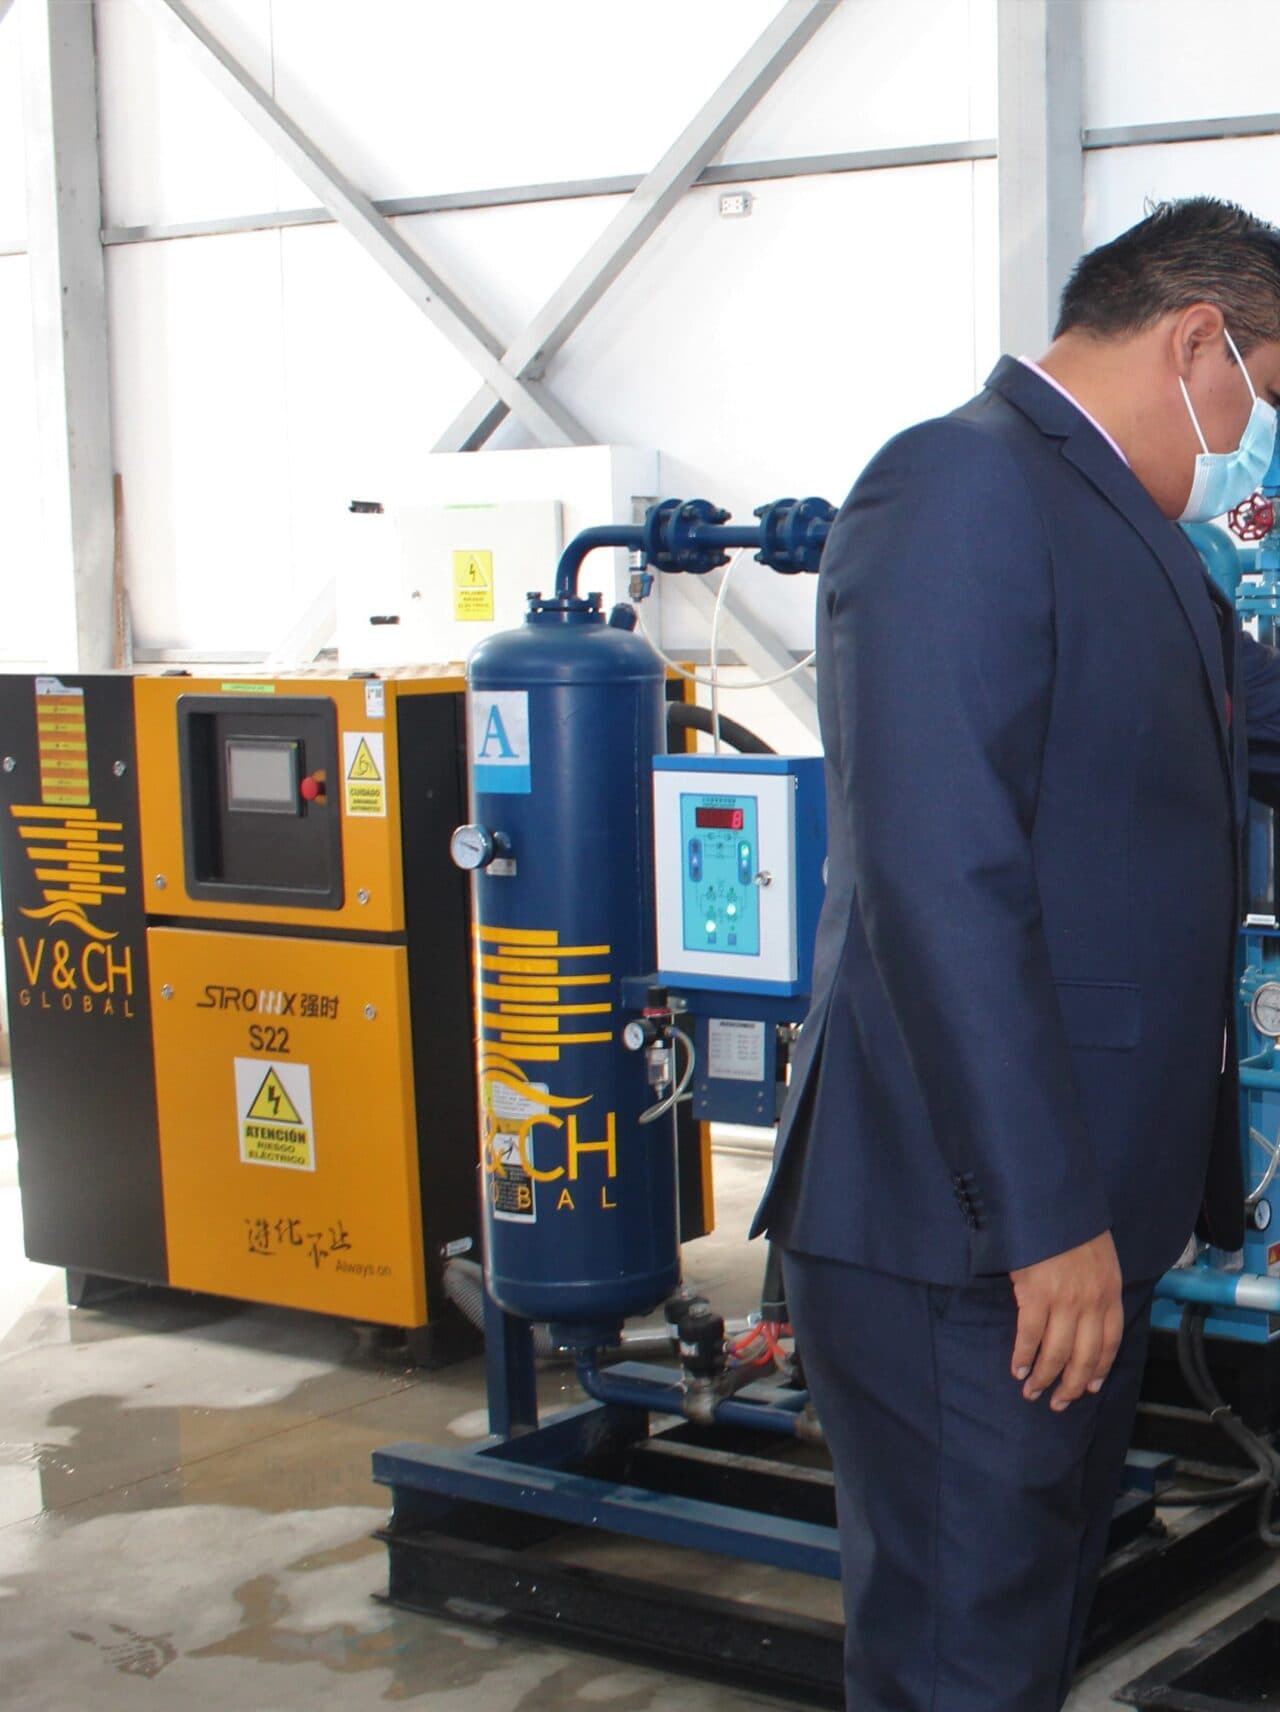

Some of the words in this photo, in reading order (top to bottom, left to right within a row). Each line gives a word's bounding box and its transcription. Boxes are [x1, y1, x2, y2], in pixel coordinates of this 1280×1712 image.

[478, 703, 519, 758] A
[19, 989, 135, 1018] GLOBAL
[249, 1024, 290, 1053] S22
